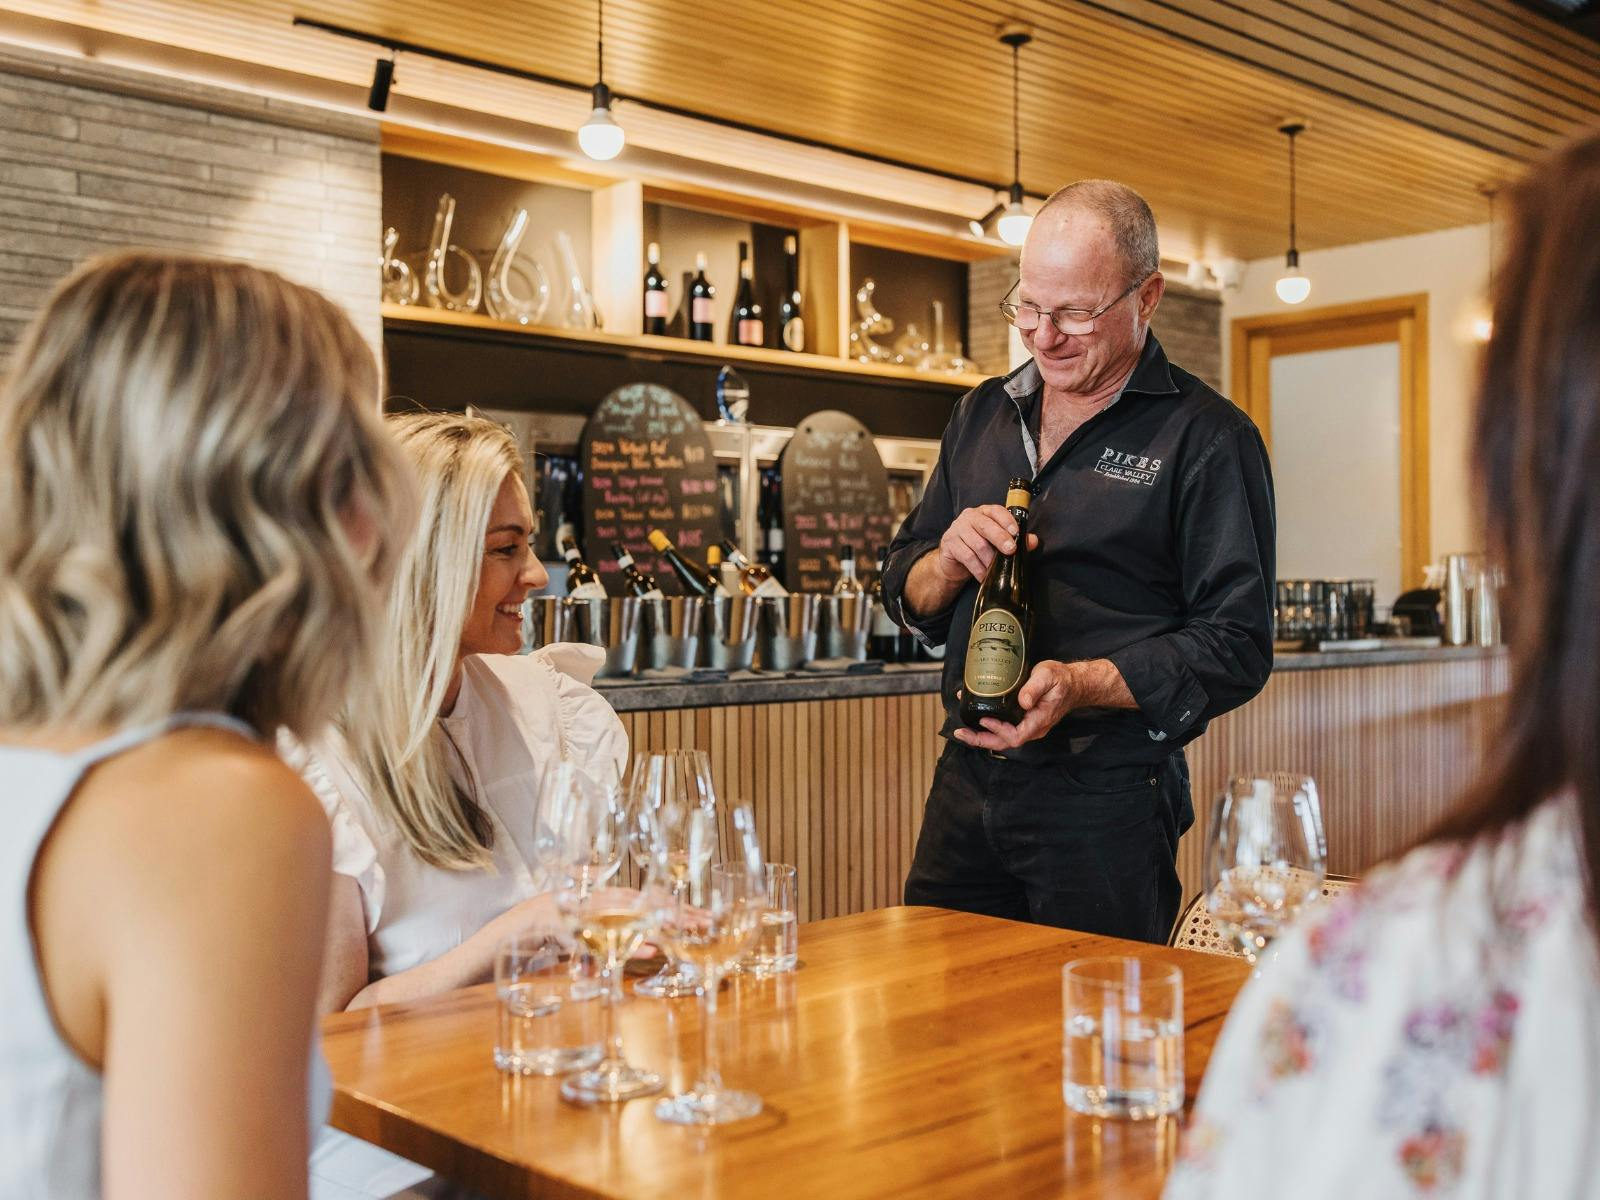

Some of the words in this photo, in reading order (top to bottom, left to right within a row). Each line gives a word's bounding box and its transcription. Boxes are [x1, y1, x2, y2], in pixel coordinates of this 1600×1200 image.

[1101, 446, 1162, 471] PIKES
[1100, 464, 1123, 474] CLARE
[1124, 469, 1151, 480] VALLEY
[979, 622, 1015, 635] PIKES
